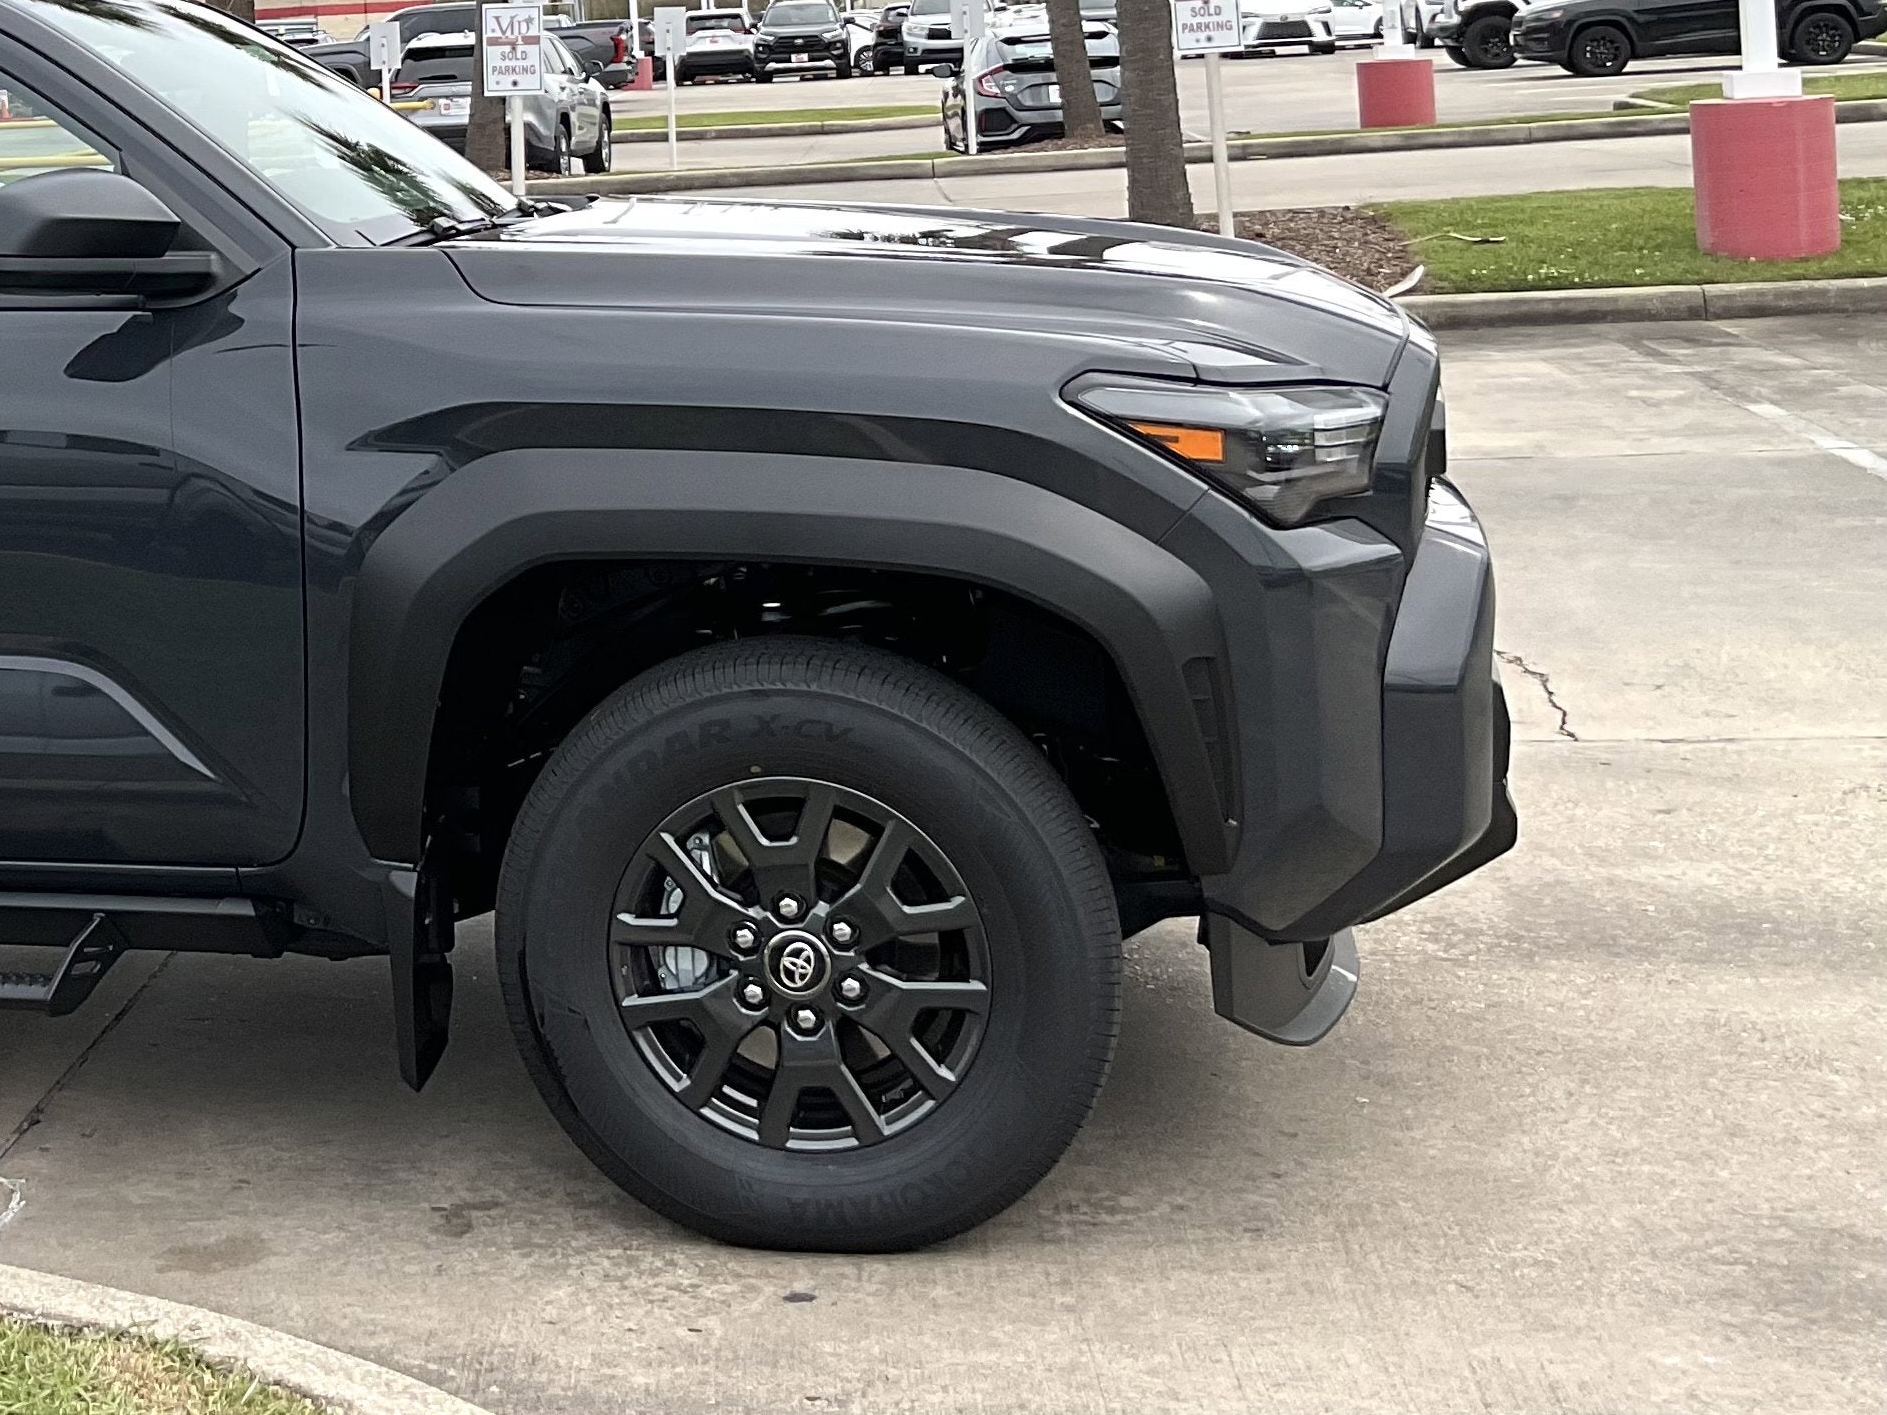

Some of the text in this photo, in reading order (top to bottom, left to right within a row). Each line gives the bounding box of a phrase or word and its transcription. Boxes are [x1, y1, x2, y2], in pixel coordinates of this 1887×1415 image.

[1190, 5, 1222, 18] SOLD
[1181, 20, 1233, 34] PARKING
[499, 50, 528, 61] SOLD
[491, 64, 536, 76] PARKING
